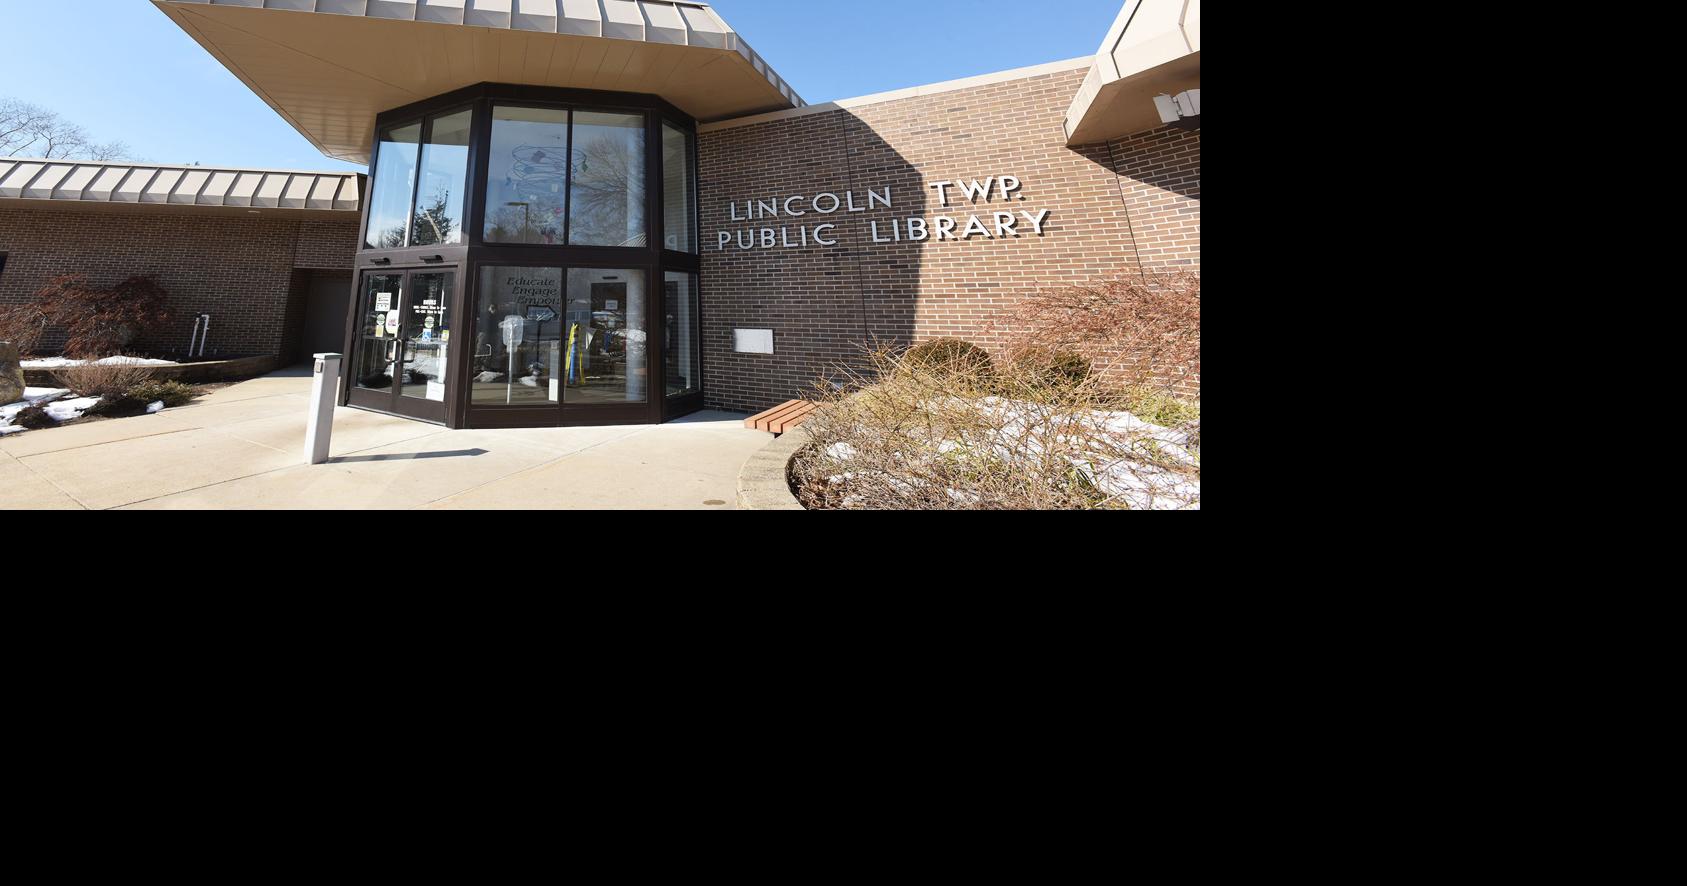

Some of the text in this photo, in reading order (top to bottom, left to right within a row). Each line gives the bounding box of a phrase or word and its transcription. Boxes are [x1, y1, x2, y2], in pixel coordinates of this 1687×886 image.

[730, 175, 1023, 221] LINCOLN TWP.
[717, 208, 1048, 250] PUBLIC LIBRARY
[506, 276, 555, 286] Educate
[511, 286, 557, 298] Engage
